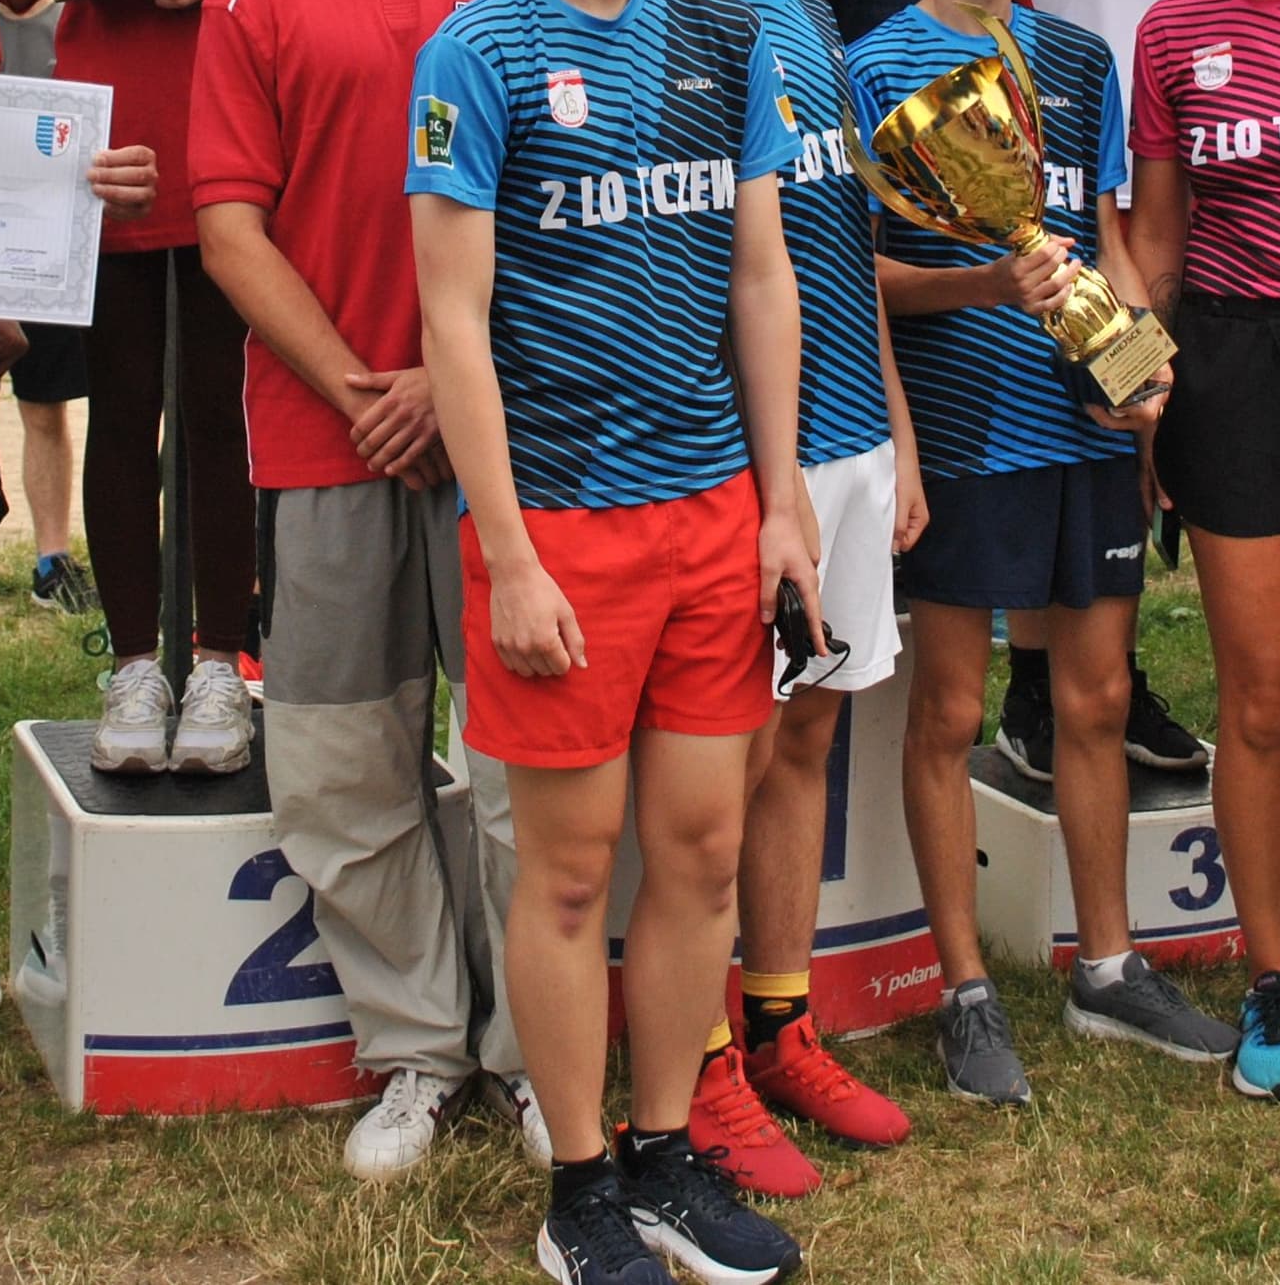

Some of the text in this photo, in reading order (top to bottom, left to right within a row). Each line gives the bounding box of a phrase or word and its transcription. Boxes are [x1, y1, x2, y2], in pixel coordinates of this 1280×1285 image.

[1191, 126, 1208, 166] 2
[1216, 118, 1262, 162] LO
[580, 170, 628, 228] LO
[636, 158, 736, 219] TCZEW
[1168, 825, 1227, 912] 3
[223, 847, 347, 1007] 2
[886, 961, 942, 998] polani
